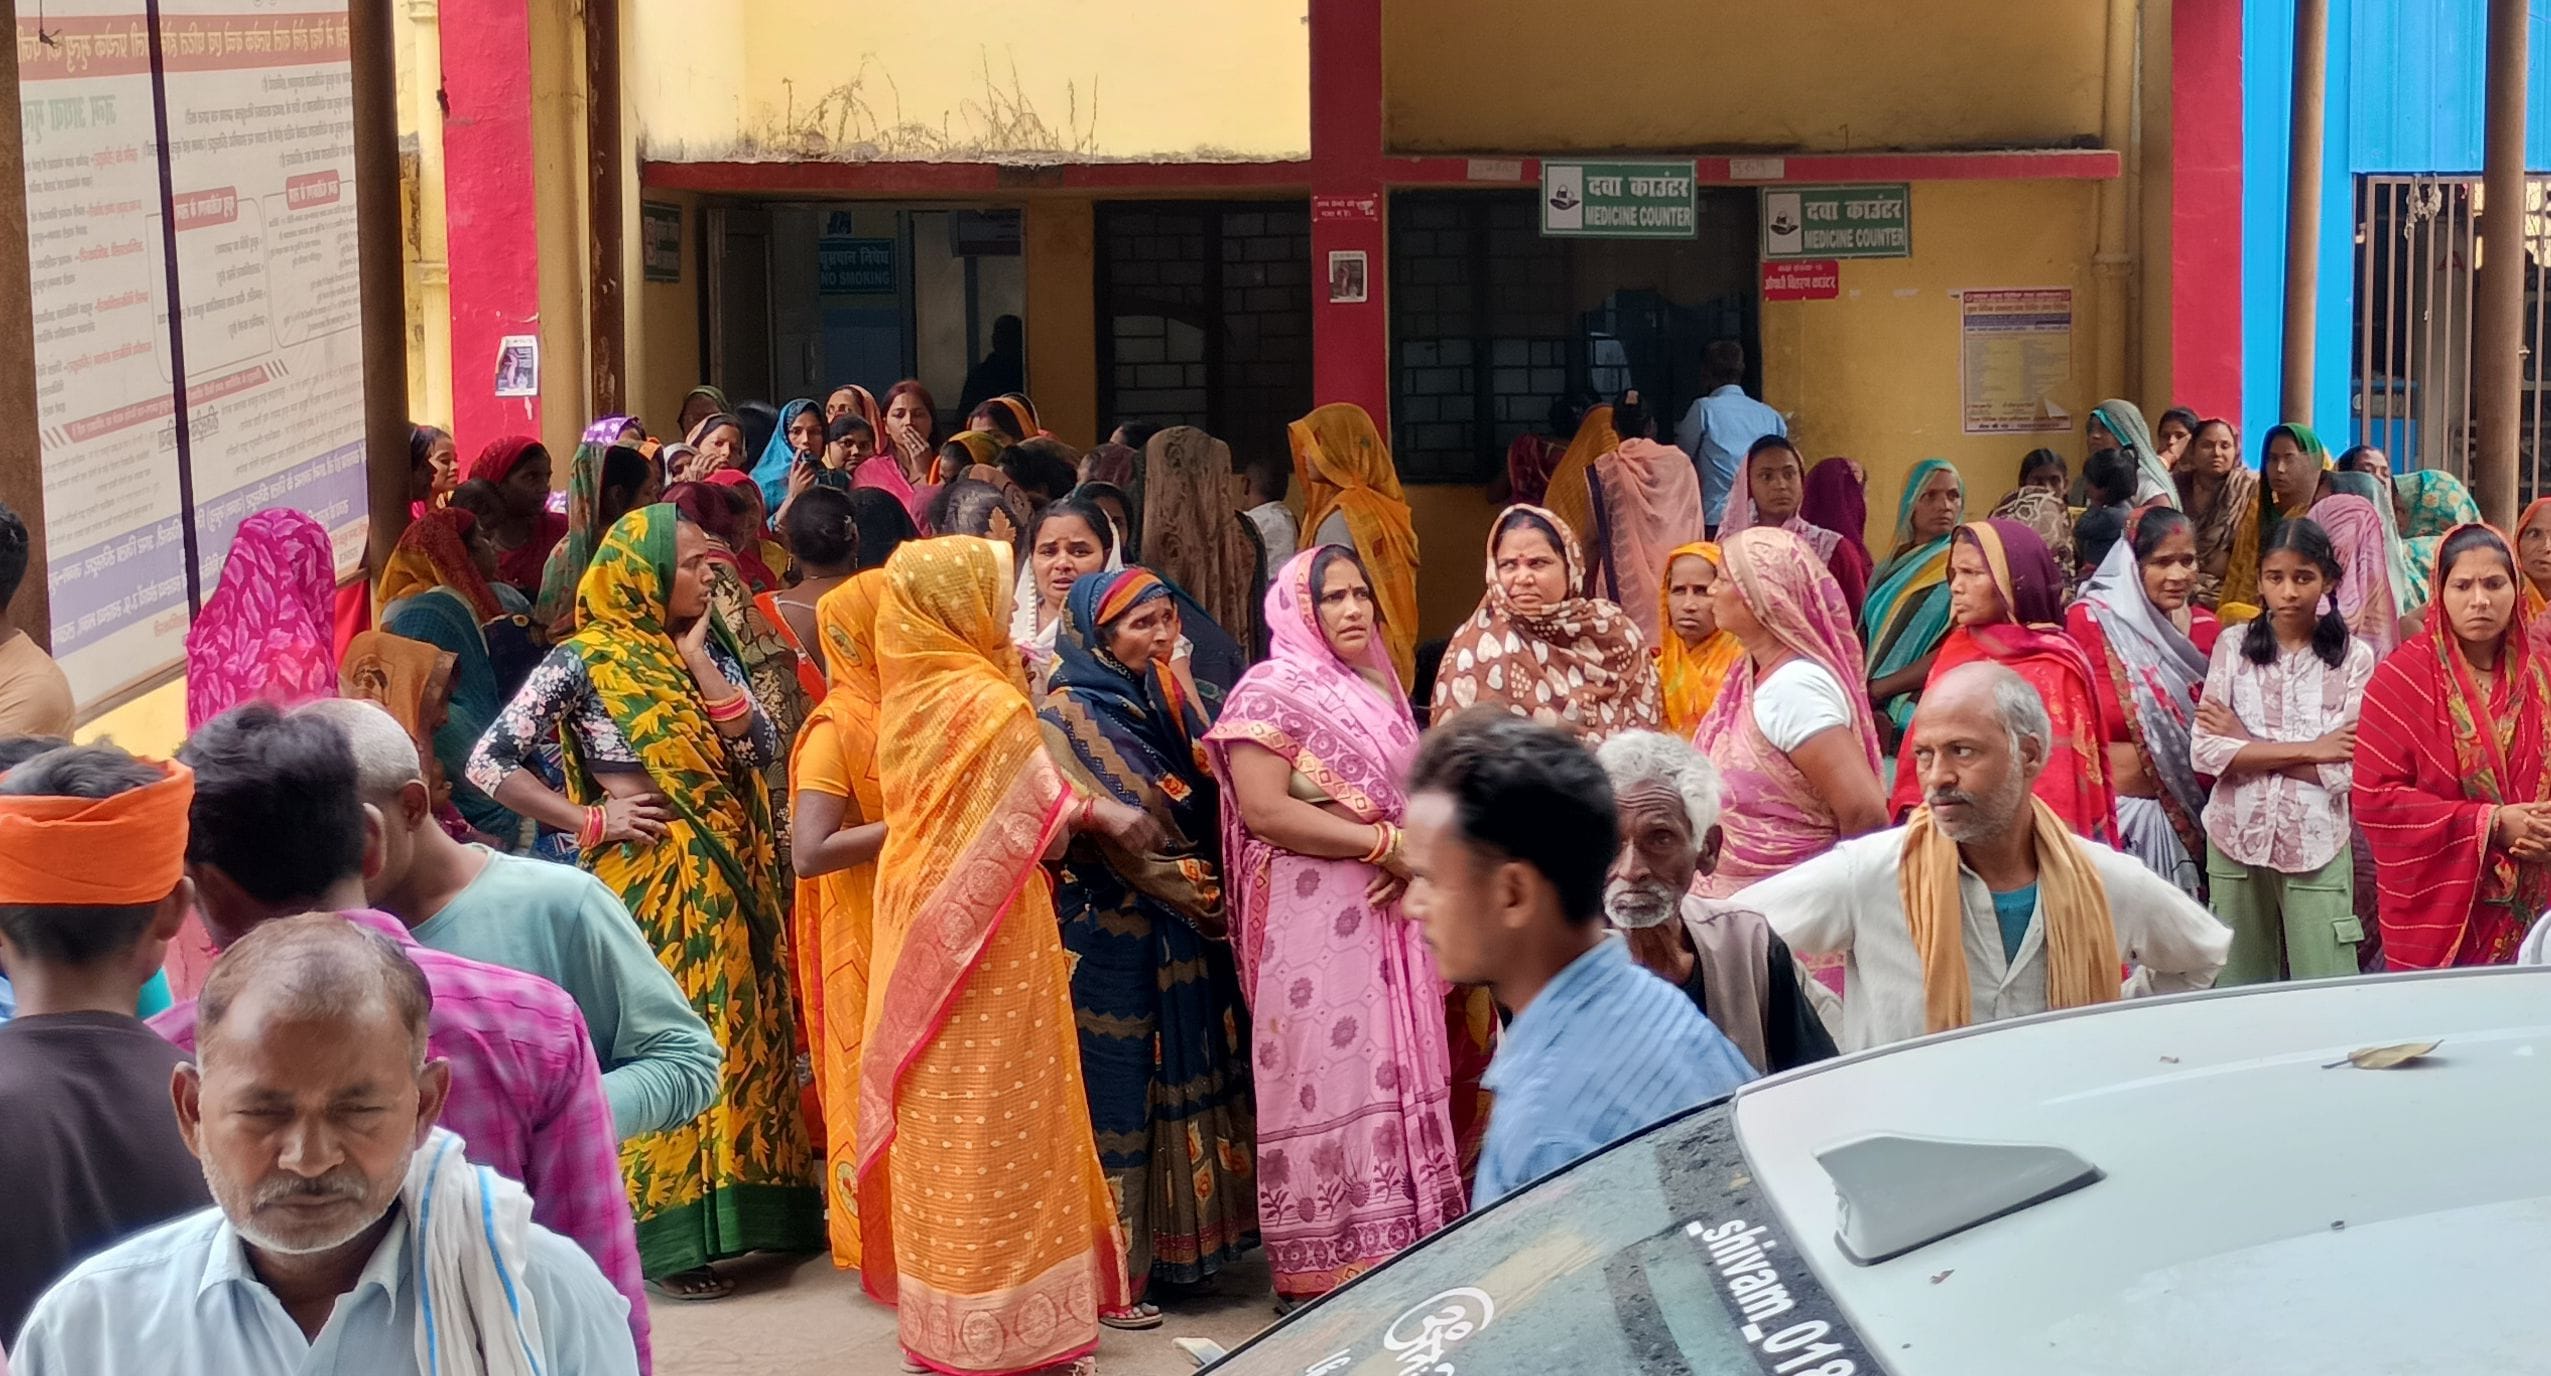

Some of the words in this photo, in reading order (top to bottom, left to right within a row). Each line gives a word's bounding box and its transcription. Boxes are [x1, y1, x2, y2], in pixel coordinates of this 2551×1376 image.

[1586, 176, 1623, 197] दवा
[1628, 171, 1690, 197] काउंटर
[1584, 206, 1638, 226] MEDICINE
[1640, 205, 1692, 226] COUNTER
[1805, 201, 1839, 221] दवा
[1844, 194, 1903, 219] काउंटर
[1804, 229, 1854, 248] MEDICINE
[1856, 227, 1904, 248] COUNTER
[820, 271, 837, 287] NO
[839, 270, 890, 286] SMOKING
